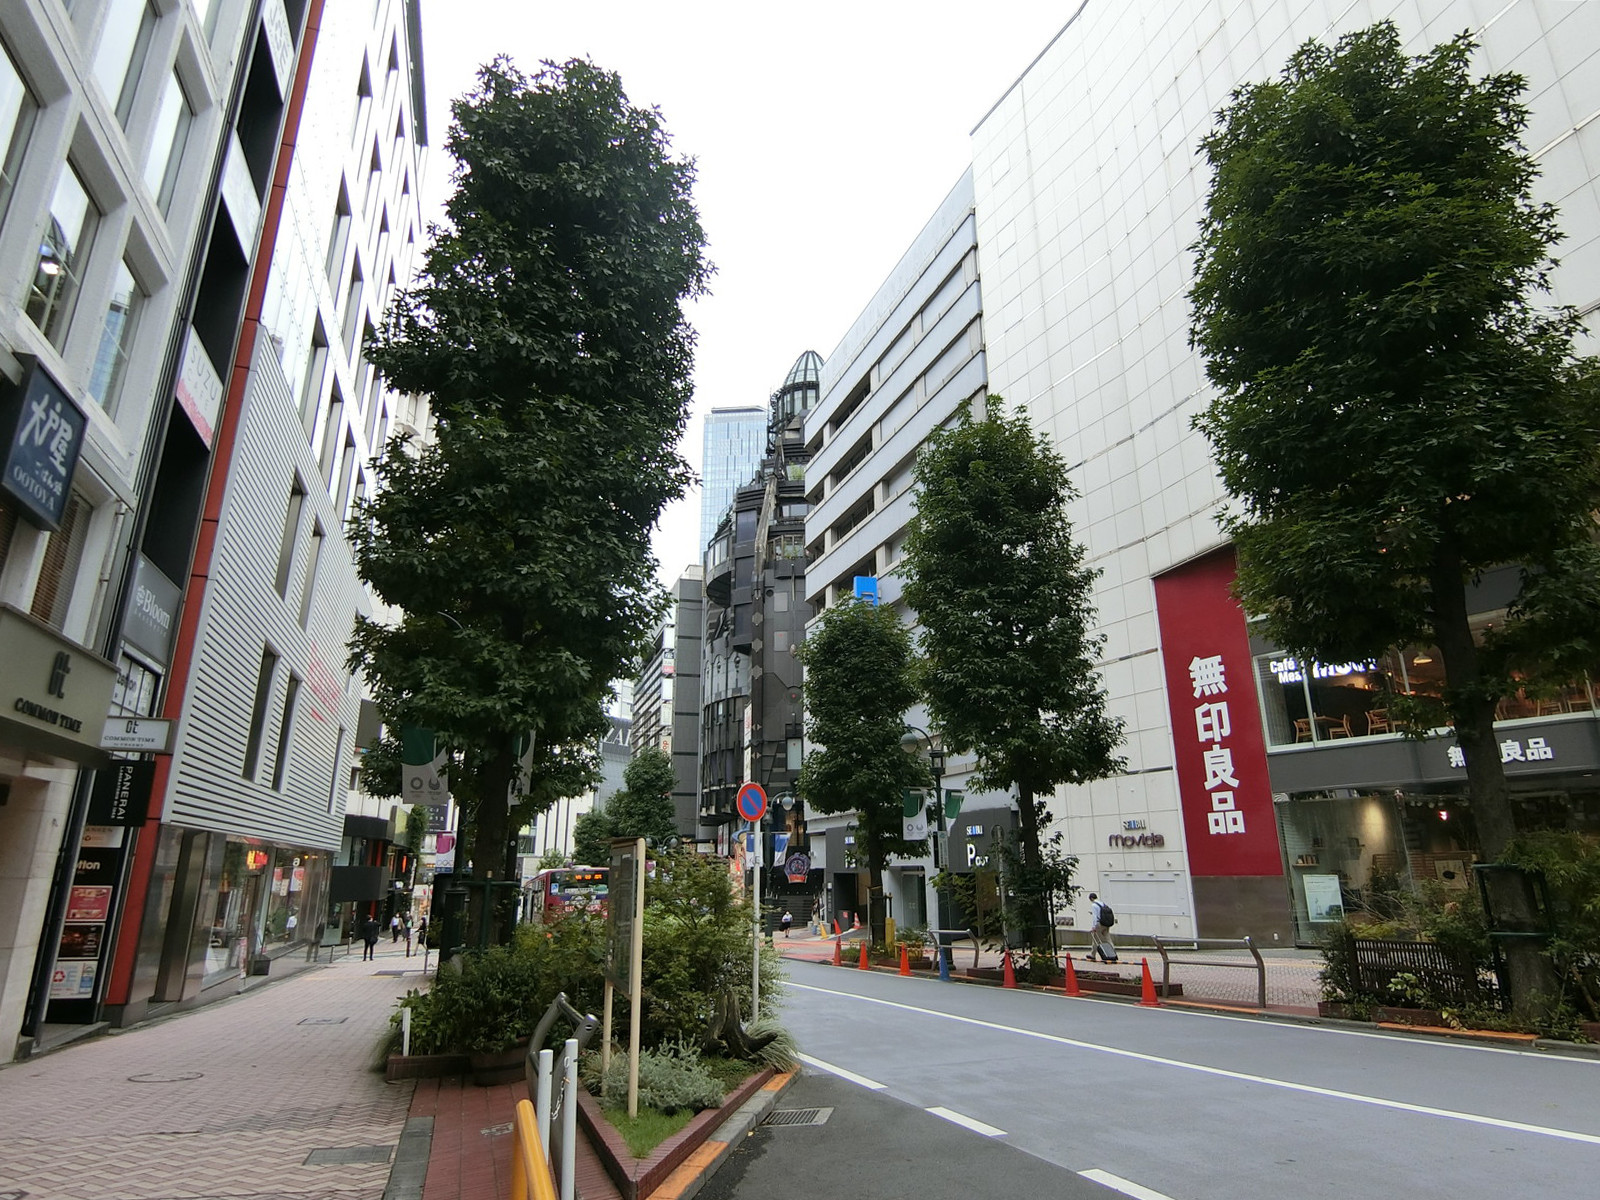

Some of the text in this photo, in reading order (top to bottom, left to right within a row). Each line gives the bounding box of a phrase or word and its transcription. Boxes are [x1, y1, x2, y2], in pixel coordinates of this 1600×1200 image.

[191, 345, 219, 401] SUZU
[19, 393, 73, 477] 大戸屋
[12, 464, 56, 511] OOTOYA
[143, 589, 171, 629] Bloom
[1269, 657, 1297, 674] Café
[1278, 671, 1303, 684] Mea
[14, 697, 83, 734] COMMON TIME
[1188, 654, 1246, 835] 無印良品
[1447, 737, 1554, 768] 無良品
[117, 766, 134, 820] PANERAI
[1108, 832, 1165, 849] movida
[1123, 819, 1147, 830] SEIBU
[77, 859, 101, 871] tion
